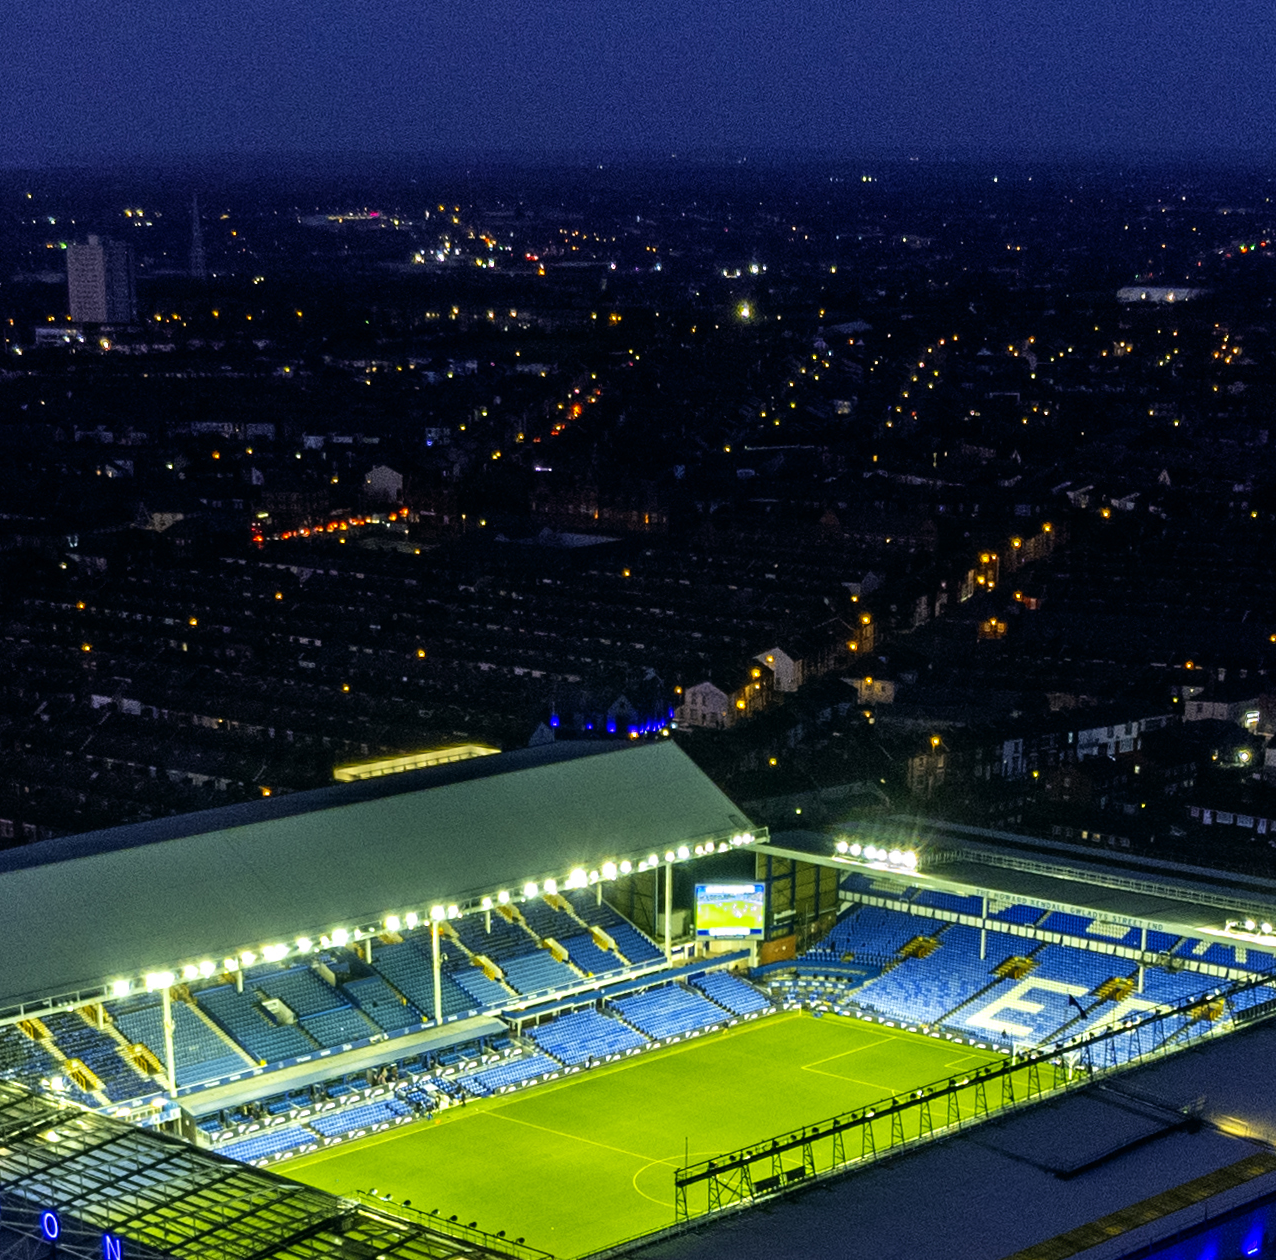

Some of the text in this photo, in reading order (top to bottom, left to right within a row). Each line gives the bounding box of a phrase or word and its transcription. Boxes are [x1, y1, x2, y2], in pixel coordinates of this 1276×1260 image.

[976, 889, 1164, 931] THE HOWARD KENDALL GWLADYS STREET END
